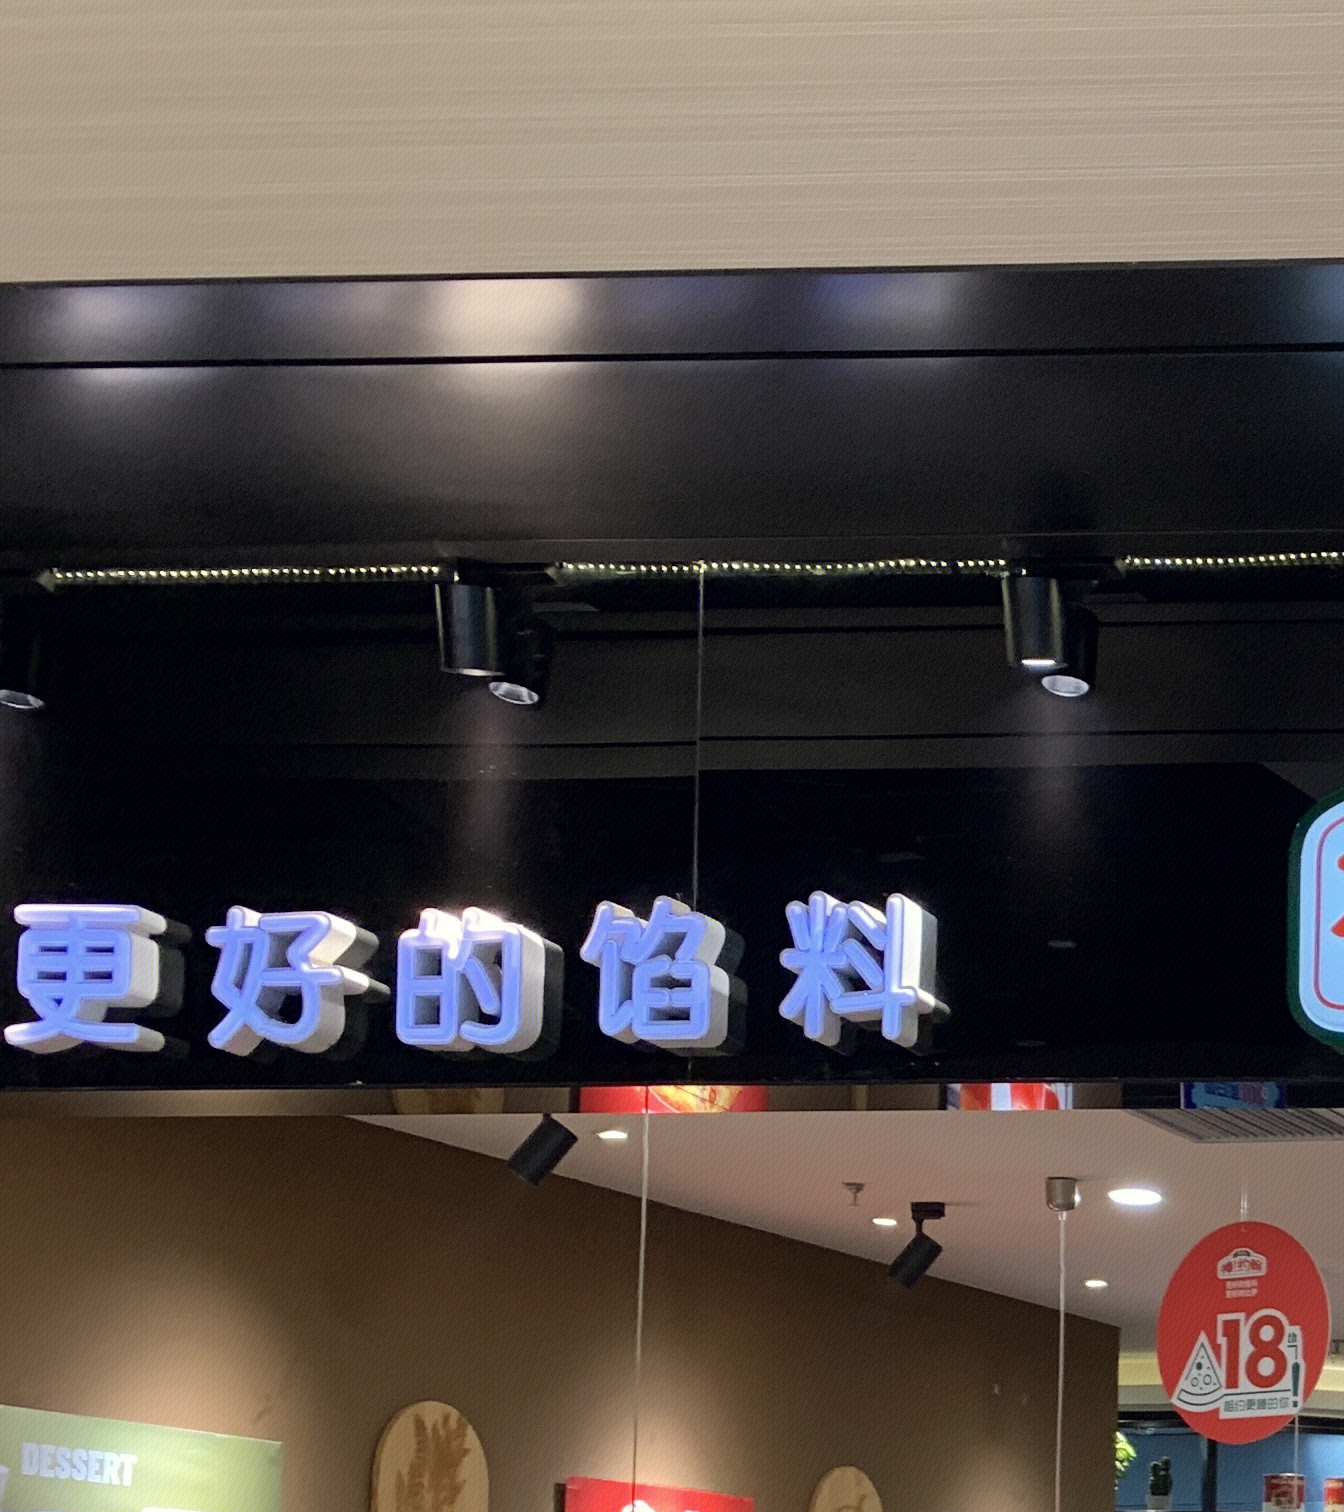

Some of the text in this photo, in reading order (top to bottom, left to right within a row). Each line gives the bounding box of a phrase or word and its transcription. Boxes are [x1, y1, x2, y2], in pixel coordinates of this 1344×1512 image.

[3, 890, 945, 1052] 更好的馅料
[1221, 1314, 1288, 1389] 18
[20, 1442, 137, 1487] DESSERT
